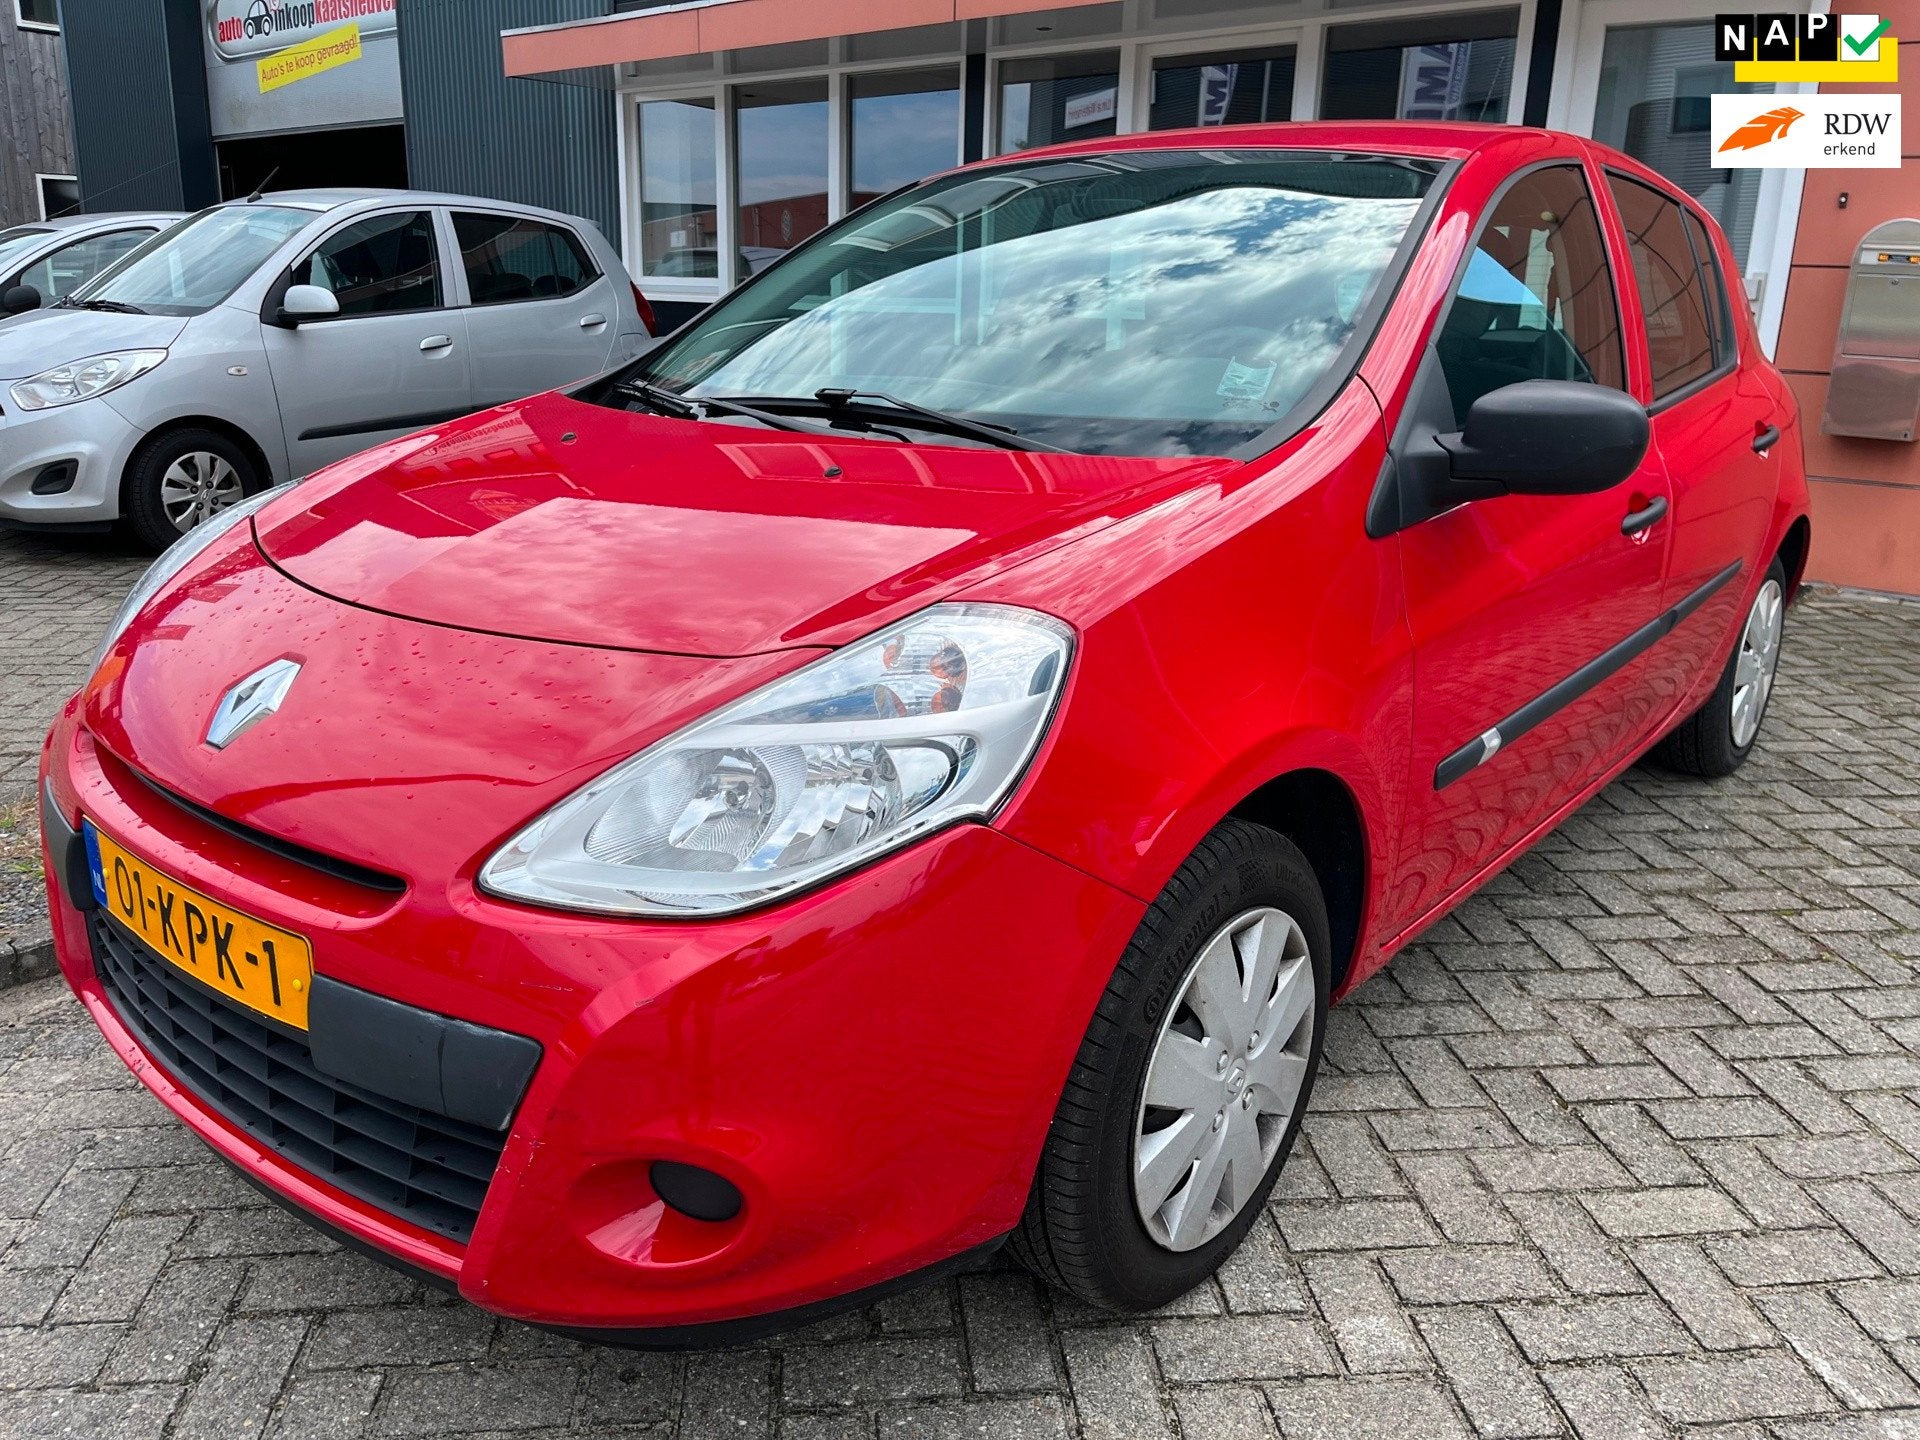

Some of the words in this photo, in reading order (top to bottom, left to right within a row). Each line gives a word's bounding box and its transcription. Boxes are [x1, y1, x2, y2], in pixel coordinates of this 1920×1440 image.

[218, 16, 243, 42] auto
[262, 63, 285, 82] Auto's
[286, 60, 294, 73] te
[295, 53, 315, 68] koop
[316, 33, 358, 65] gevraagd!
[92, 868, 105, 893] NL
[114, 855, 281, 1007] 01-KPK-1
